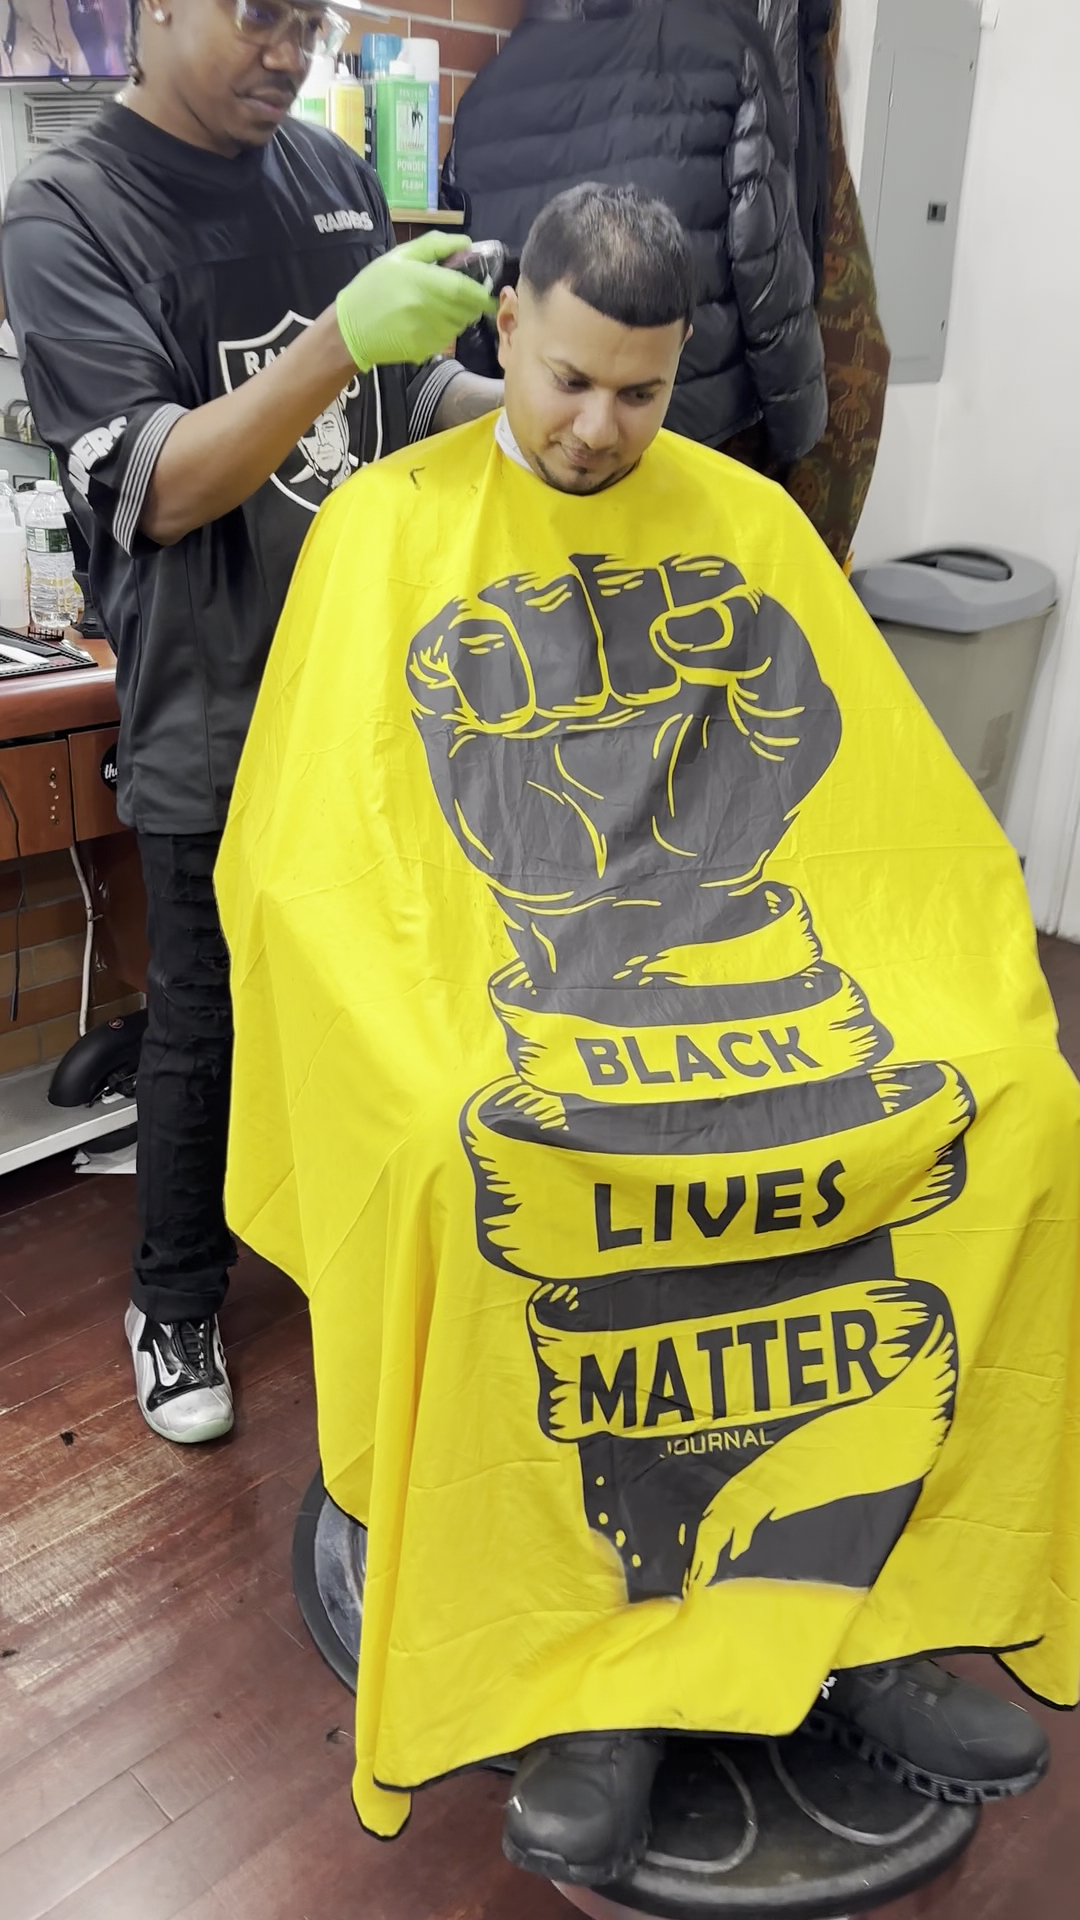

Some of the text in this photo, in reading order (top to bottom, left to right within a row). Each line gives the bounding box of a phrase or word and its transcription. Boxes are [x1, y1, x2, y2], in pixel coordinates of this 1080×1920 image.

[574, 1025, 822, 1086] BLACK
[593, 1159, 847, 1252] LIVES
[578, 1308, 893, 1429] MATTER
